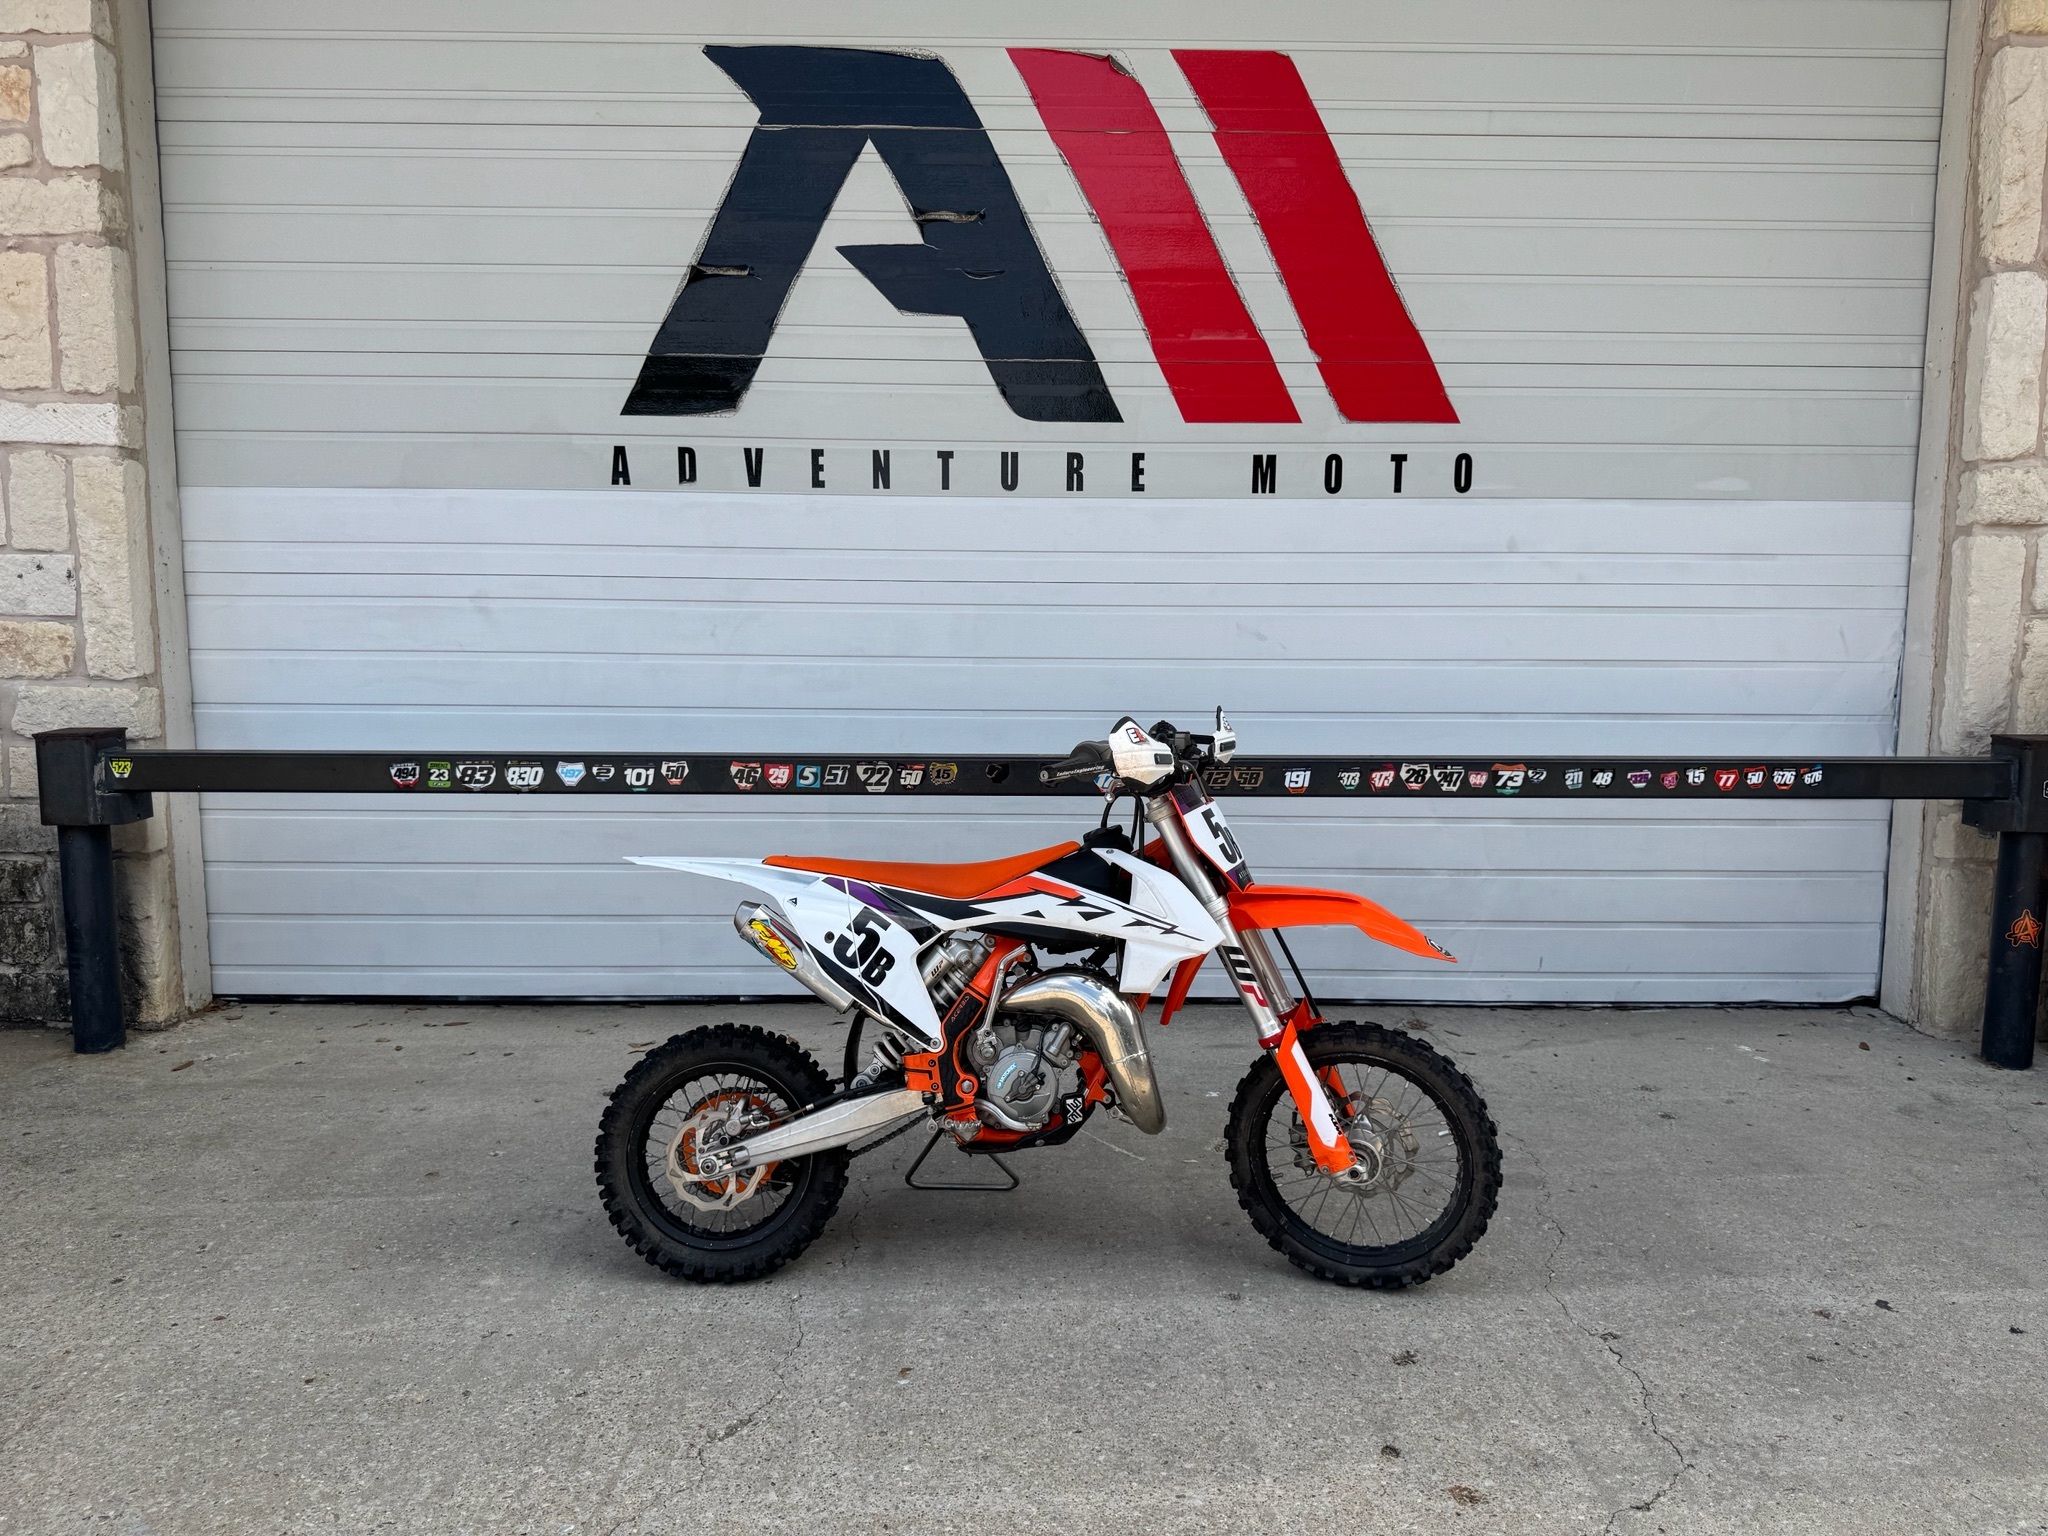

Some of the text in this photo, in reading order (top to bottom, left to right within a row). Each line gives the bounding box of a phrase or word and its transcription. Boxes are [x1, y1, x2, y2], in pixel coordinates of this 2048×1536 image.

[611, 445, 1473, 495] ADVENTURE MOTO
[112, 761, 131, 773] 523
[394, 767, 417, 780] 494
[430, 769, 449, 781] 23
[560, 768, 583, 779] 497
[596, 768, 615, 777] 2
[666, 765, 684, 779] 50
[934, 770, 950, 779] 15
[460, 766, 494, 785] 83
[507, 767, 544, 785] 830
[624, 768, 655, 786] 101
[733, 768, 758, 784] 46
[768, 768, 789, 784] 29
[800, 767, 816, 785] 5
[863, 767, 889, 786] 22
[900, 769, 923, 785] 50
[1206, 771, 1229, 787] 12
[1284, 771, 1312, 788] 191
[1371, 771, 1395, 787] 373
[1405, 768, 1427, 784] 28
[1437, 771, 1463, 787] 247
[1469, 774, 1487, 785] 644
[1495, 770, 1525, 787] 73
[1565, 771, 1583, 785] 211
[1592, 771, 1613, 785] 48
[1686, 769, 1705, 784] 15
[1719, 774, 1735, 786] 77
[1747, 771, 1763, 785] 50
[931, 959, 944, 977] WP
[1328, 1113, 1342, 1136] KTM
